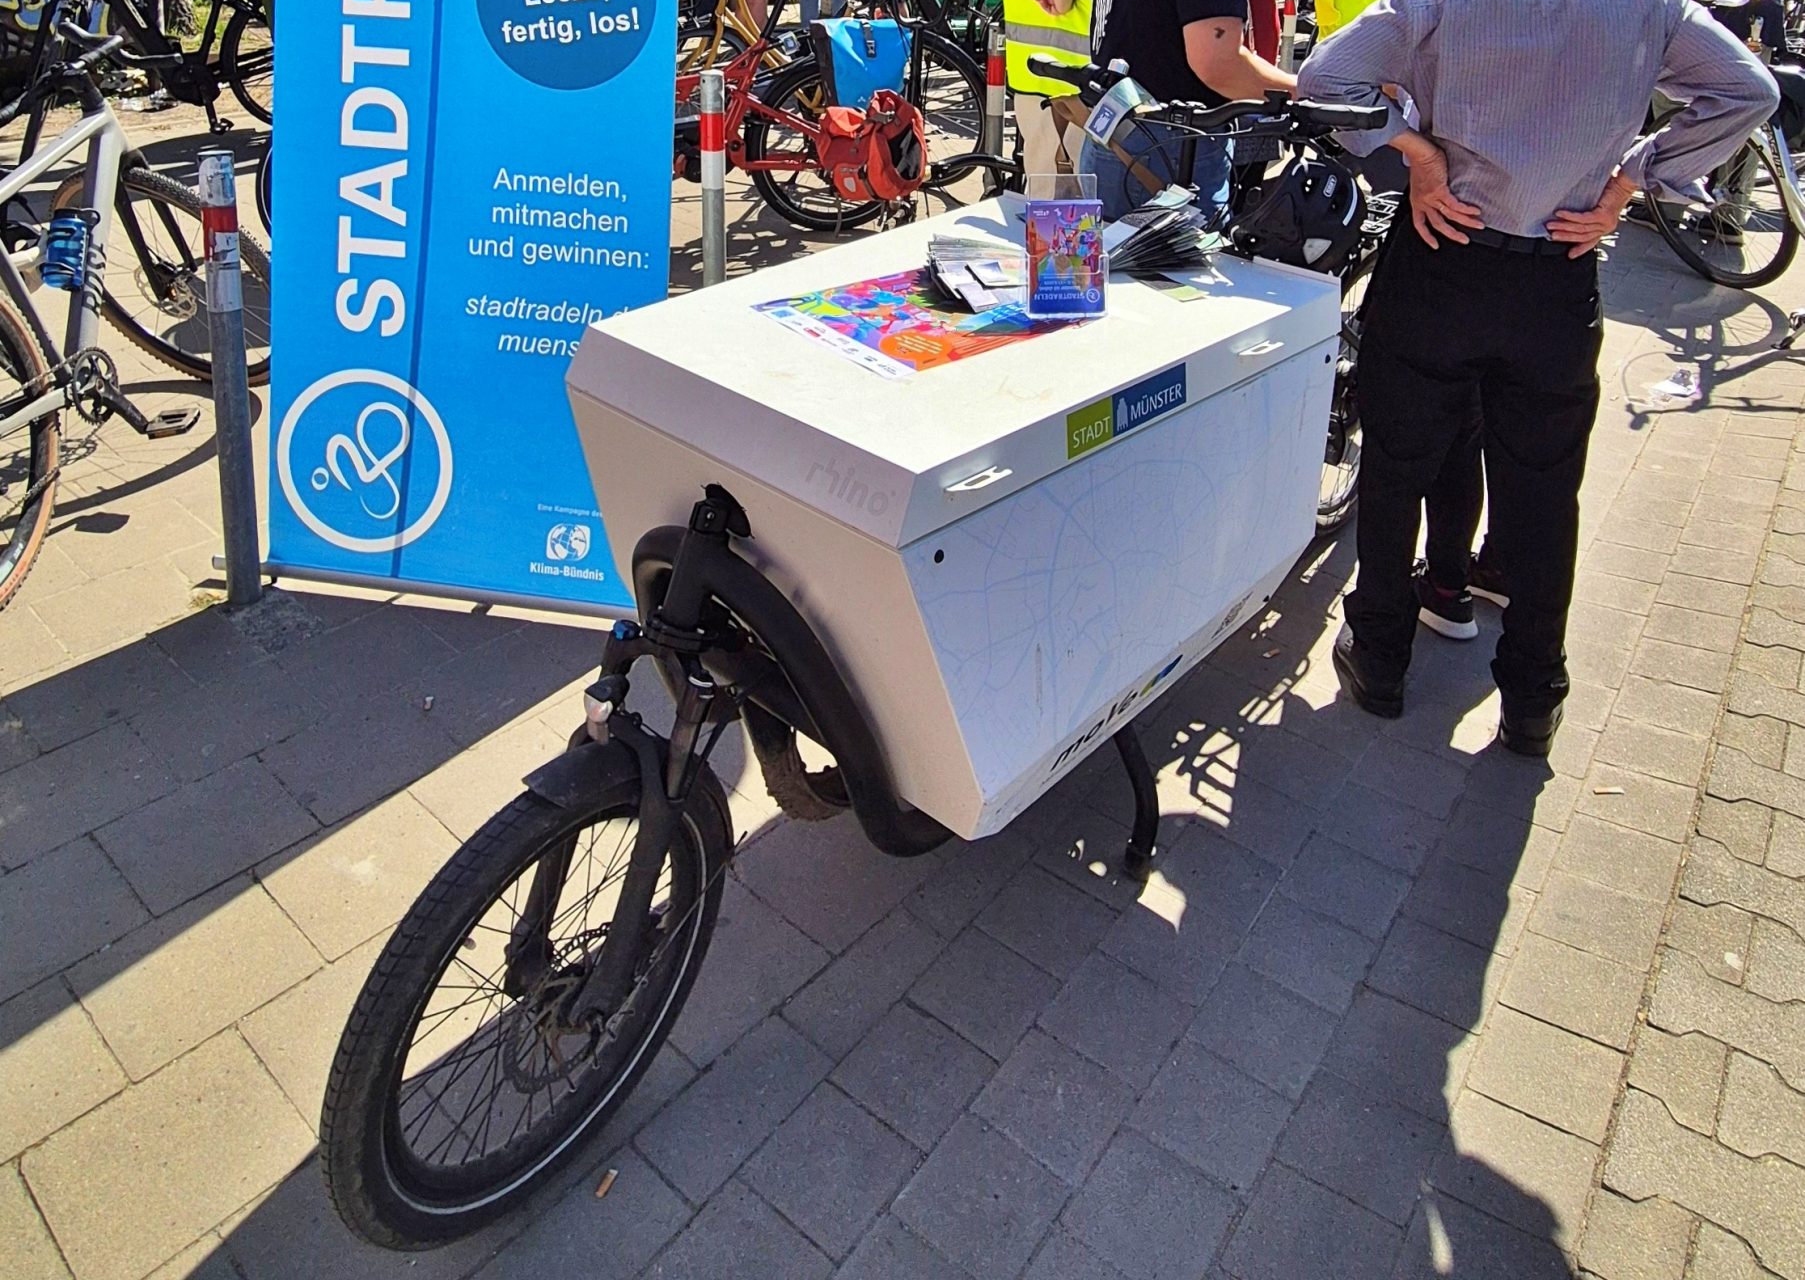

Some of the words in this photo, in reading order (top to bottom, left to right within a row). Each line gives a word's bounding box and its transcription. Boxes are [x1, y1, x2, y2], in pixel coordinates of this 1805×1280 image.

[501, 17, 581, 44] fertig,
[589, 7, 640, 34] los!
[493, 168, 627, 202] Anmelden,
[492, 204, 628, 233] mitmachen
[469, 236, 514, 258] und
[522, 241, 649, 270] gewinnen:
[81, 243, 107, 319] ROSE
[1072, 415, 1111, 449] STADT
[1130, 383, 1182, 422] MÜNSTER
[804, 457, 890, 518] rhino
[537, 503, 553, 512] Eine
[554, 505, 590, 516] Kampagne
[530, 561, 605, 582] Klima-Bündnis
